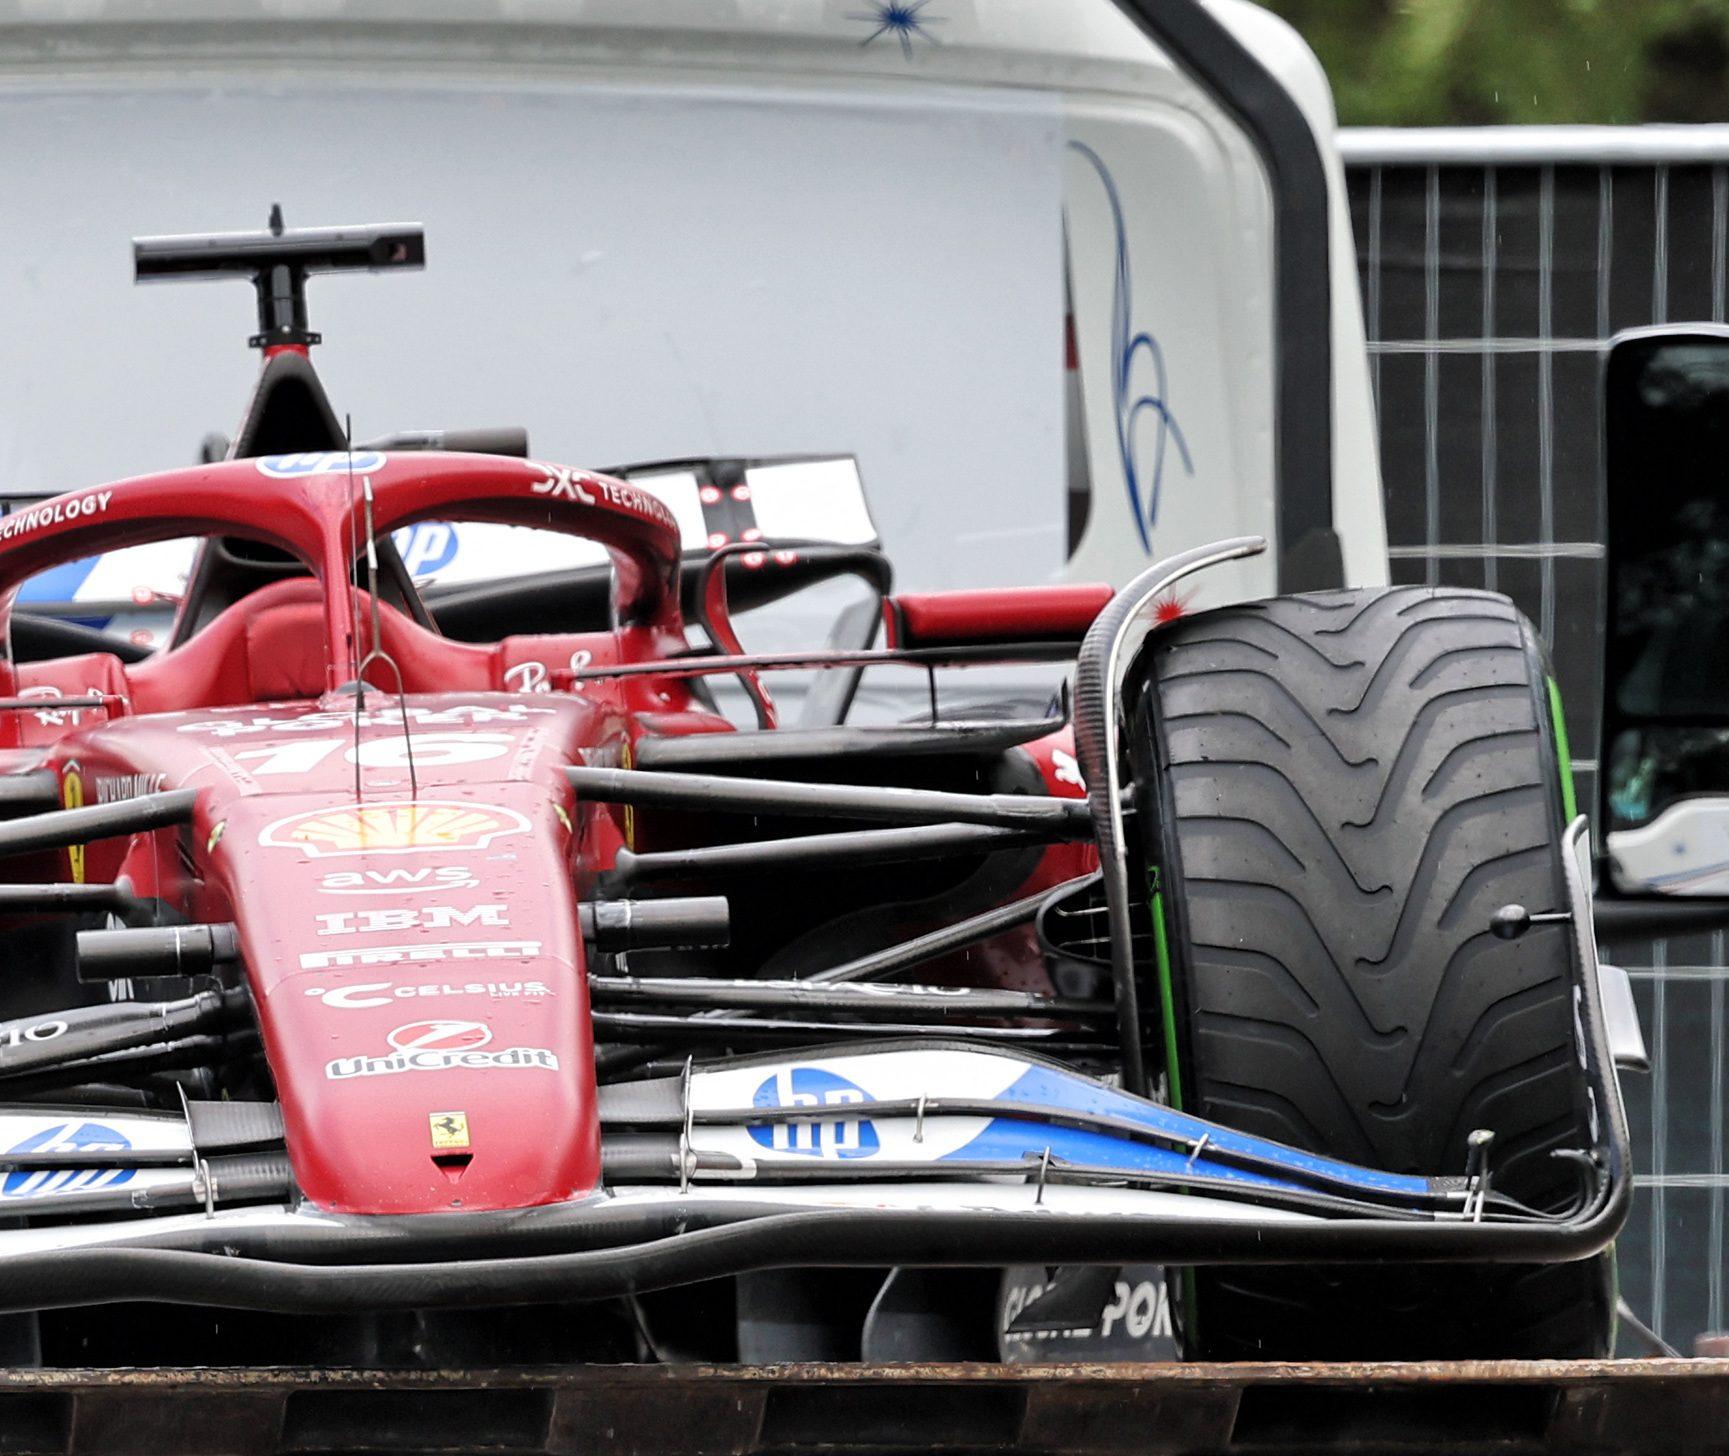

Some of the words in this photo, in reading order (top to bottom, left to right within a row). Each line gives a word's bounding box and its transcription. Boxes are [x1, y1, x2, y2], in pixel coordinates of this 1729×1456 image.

[524, 461, 596, 505] DXC
[234, 732, 516, 775] 16
[322, 865, 475, 889] aws
[315, 904, 510, 936] IBM
[298, 940, 542, 969] PIRELLI
[394, 981, 548, 997] CELSIUS
[330, 1047, 556, 1077] UniCredit
[770, 1066, 872, 1158] hp
